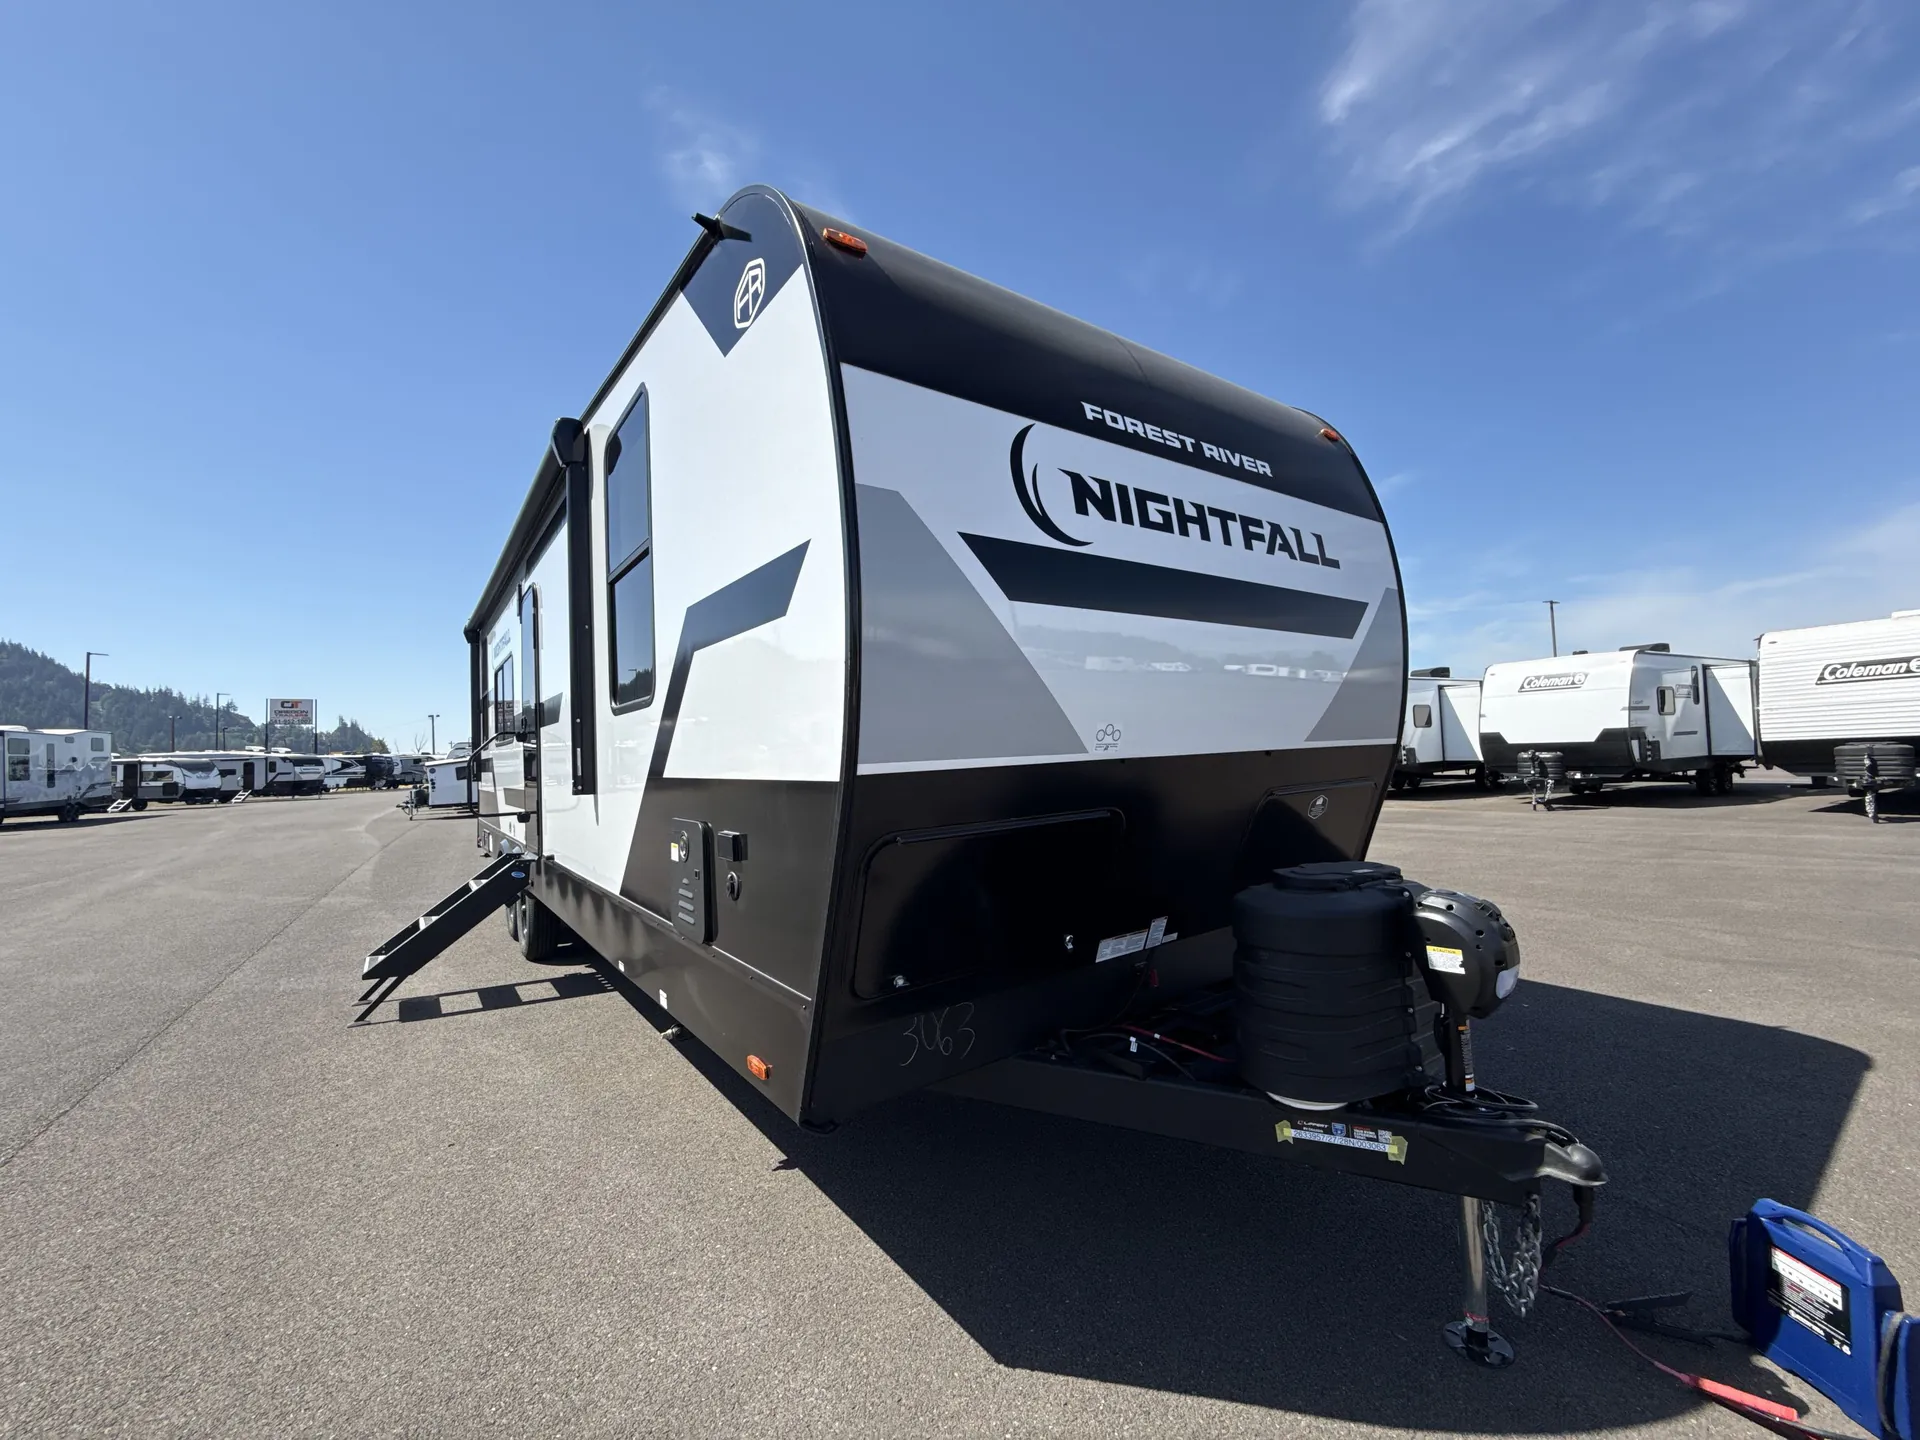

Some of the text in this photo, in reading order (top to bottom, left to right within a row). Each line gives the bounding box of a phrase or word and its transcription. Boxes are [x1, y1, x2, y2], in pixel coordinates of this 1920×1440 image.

[1080, 401, 1273, 478] FOREST RIVER
[1057, 467, 1341, 570] NIGHTFALL
[1523, 675, 1574, 689] Coleman
[1823, 661, 1908, 681] Coleman
